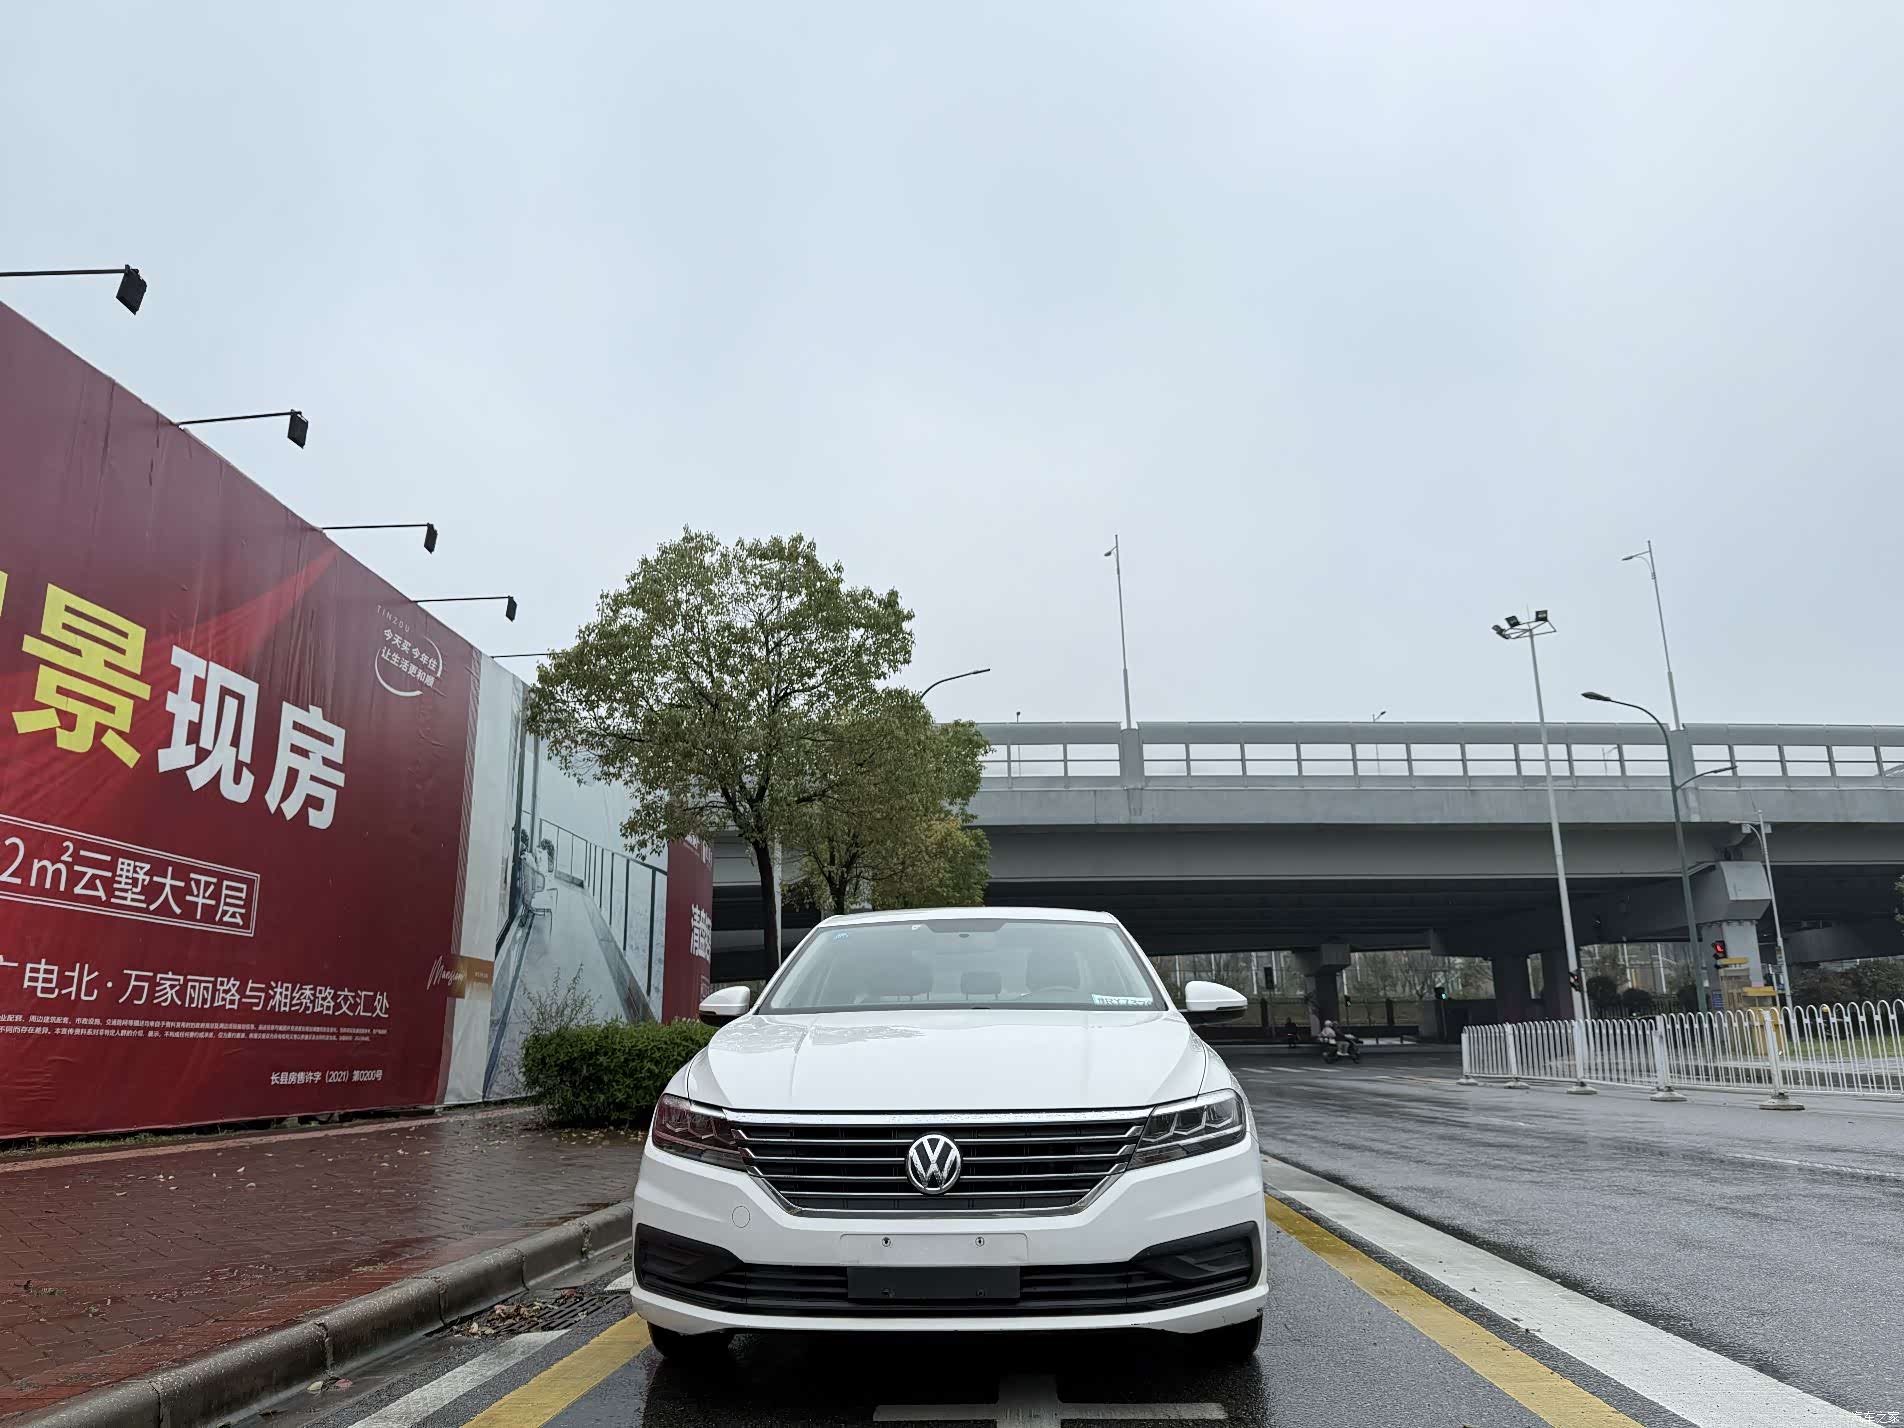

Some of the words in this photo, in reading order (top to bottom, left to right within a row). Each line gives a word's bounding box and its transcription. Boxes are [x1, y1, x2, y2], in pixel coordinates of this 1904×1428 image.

[381, 646, 435, 688] 让生活更和顺
[383, 628, 411, 654] 今天买
[411, 646, 439, 672] 今年住
[0, 571, 346, 830] 景现房
